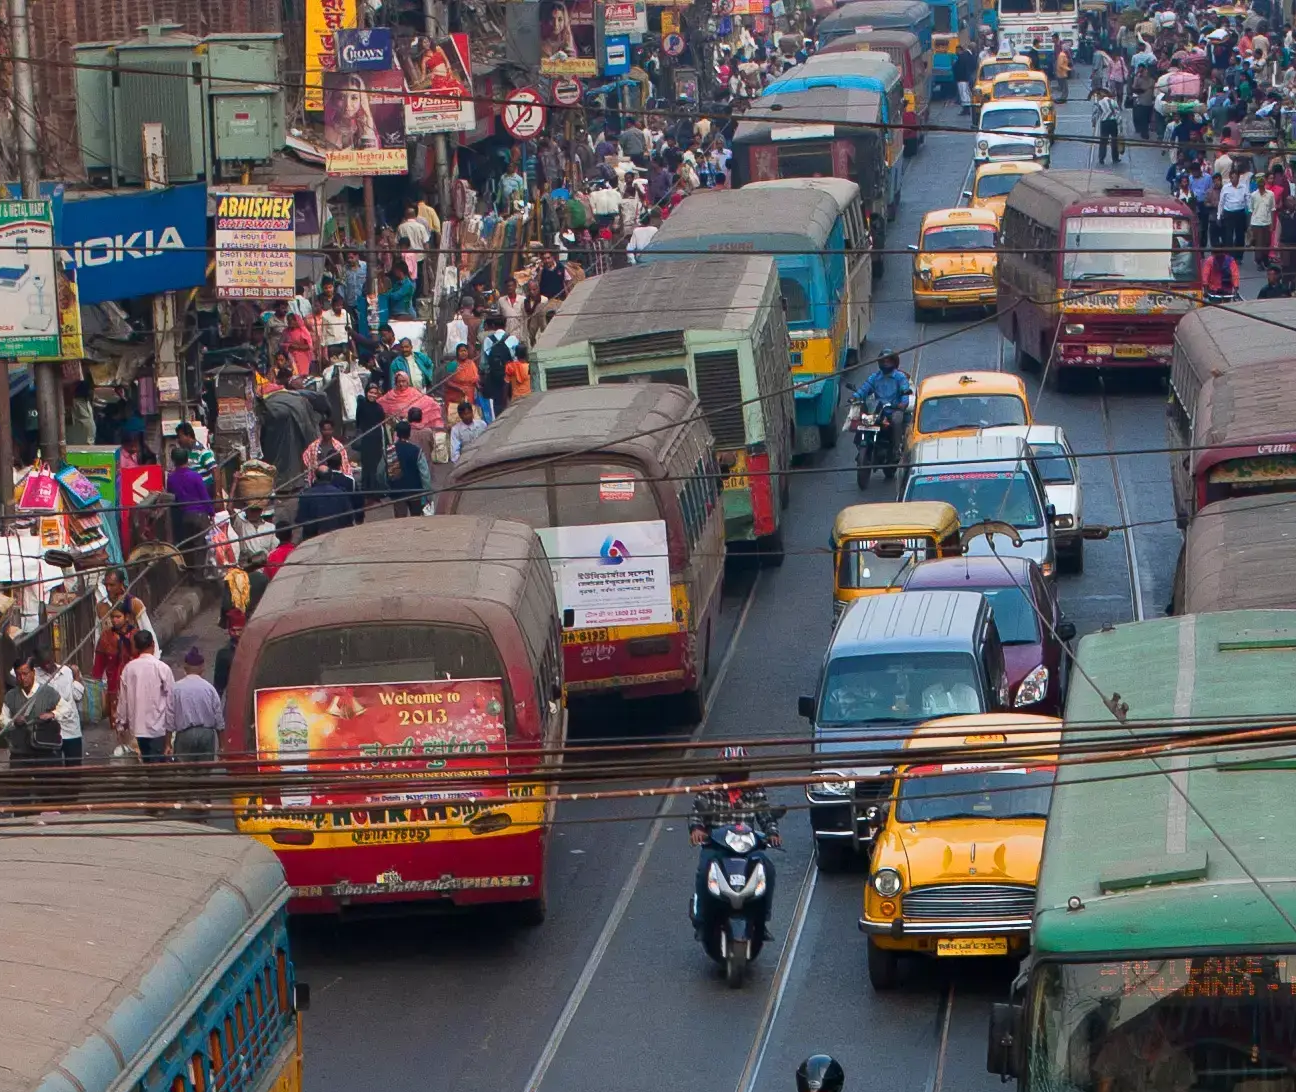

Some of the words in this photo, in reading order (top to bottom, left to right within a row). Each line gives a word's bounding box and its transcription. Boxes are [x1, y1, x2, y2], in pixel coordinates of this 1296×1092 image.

[343, 45, 384, 64] CROWN
[356, 152, 385, 164] Meghraj
[9, 203, 28, 217] METAL
[218, 197, 294, 218] ABHISHEK
[379, 692, 442, 706] Welcome
[447, 692, 460, 703] to
[399, 709, 448, 726] 2013
